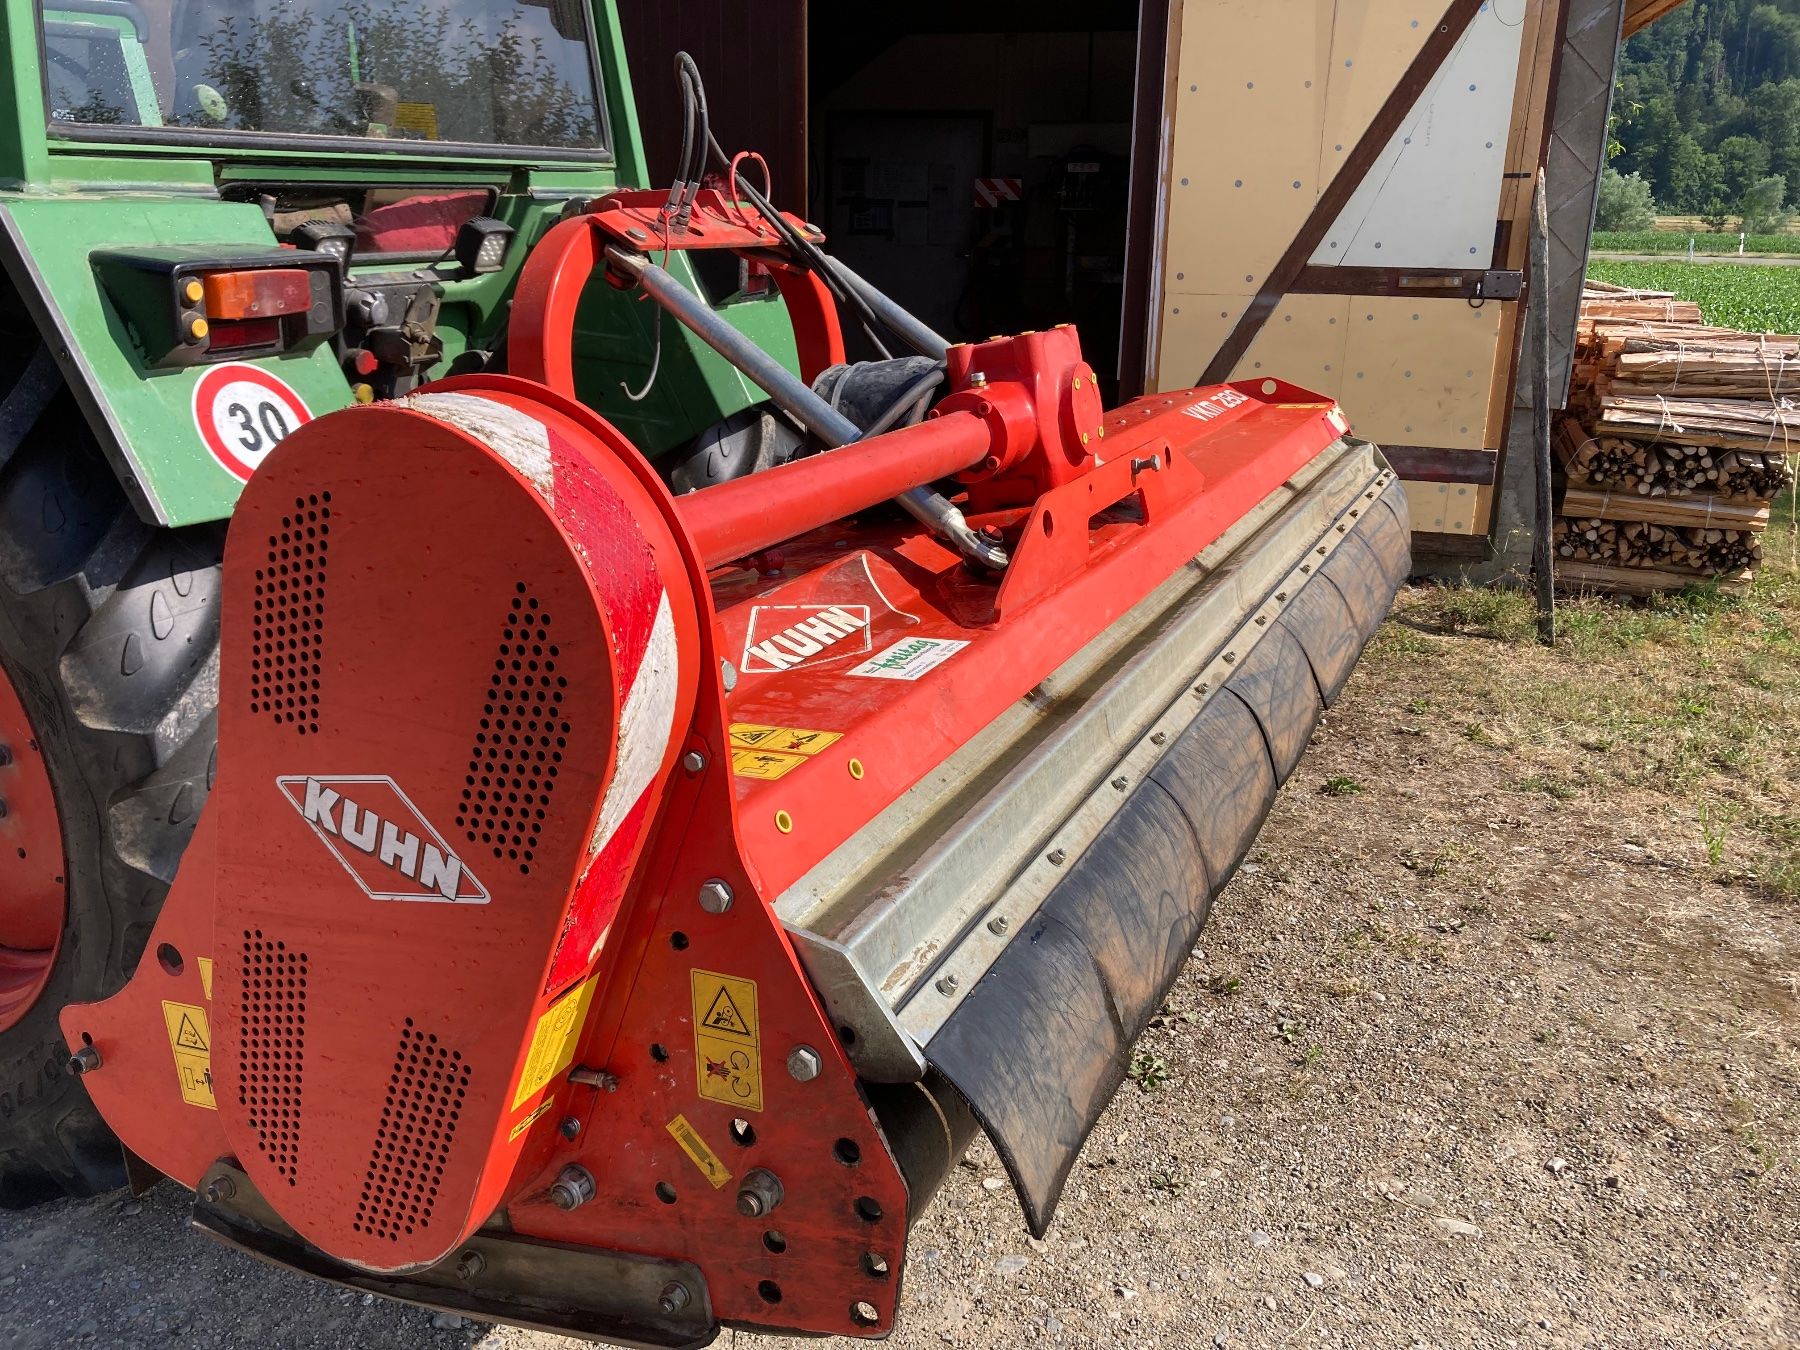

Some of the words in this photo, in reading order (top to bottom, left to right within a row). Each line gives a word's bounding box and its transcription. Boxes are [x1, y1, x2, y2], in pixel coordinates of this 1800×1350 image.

[228, 401, 289, 451] 30
[746, 606, 869, 670] KUHN
[303, 777, 462, 901] KUHN
